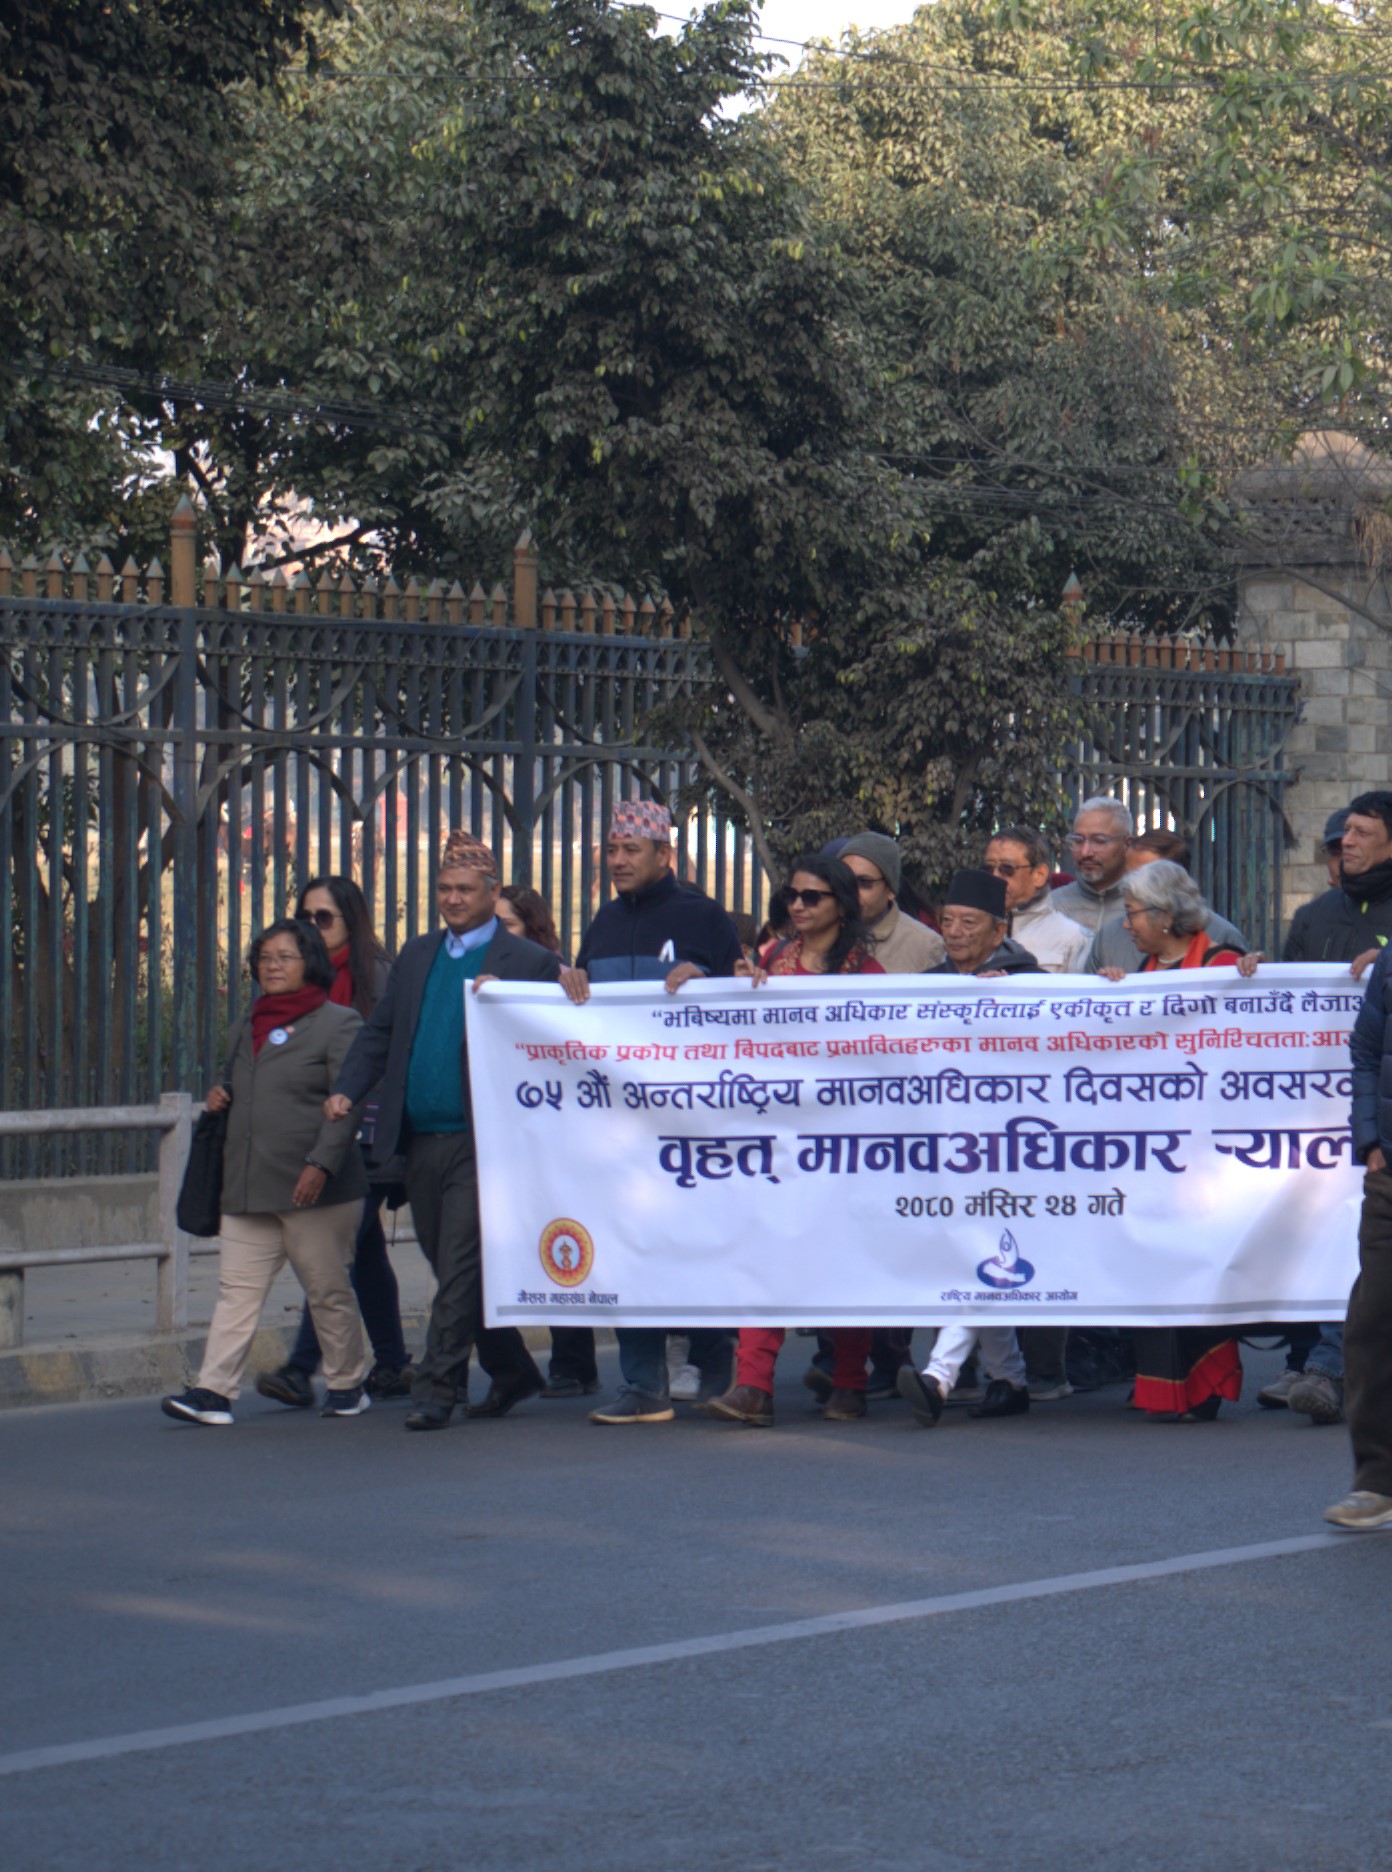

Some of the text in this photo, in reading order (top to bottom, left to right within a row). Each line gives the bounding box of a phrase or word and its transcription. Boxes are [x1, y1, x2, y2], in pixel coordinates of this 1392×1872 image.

[762, 1005, 819, 1024] मानव
[825, 999, 912, 1022] अधिकार
[916, 998, 1046, 1025] संस्कृतिलाई
[1050, 997, 1134, 1024] एकीकृत
[1139, 1000, 1156, 1017] र
[1162, 994, 1217, 1016] दिगो
[616, 1042, 679, 1063] प्रकोप
[684, 1043, 728, 1061] तथा
[978, 1036, 1040, 1053] मानव
[1047, 1031, 1168, 1052] अधिकारको
[515, 1080, 563, 1112] ७५
[815, 1066, 1051, 1106] मानवअधिकार
[1063, 1062, 1208, 1106] दिवसको
[658, 1135, 781, 1188] वृहत्
[797, 1115, 1192, 1174] मानवअधिकार
[895, 1186, 1127, 1219] २०८० मंसिर २४ गते
